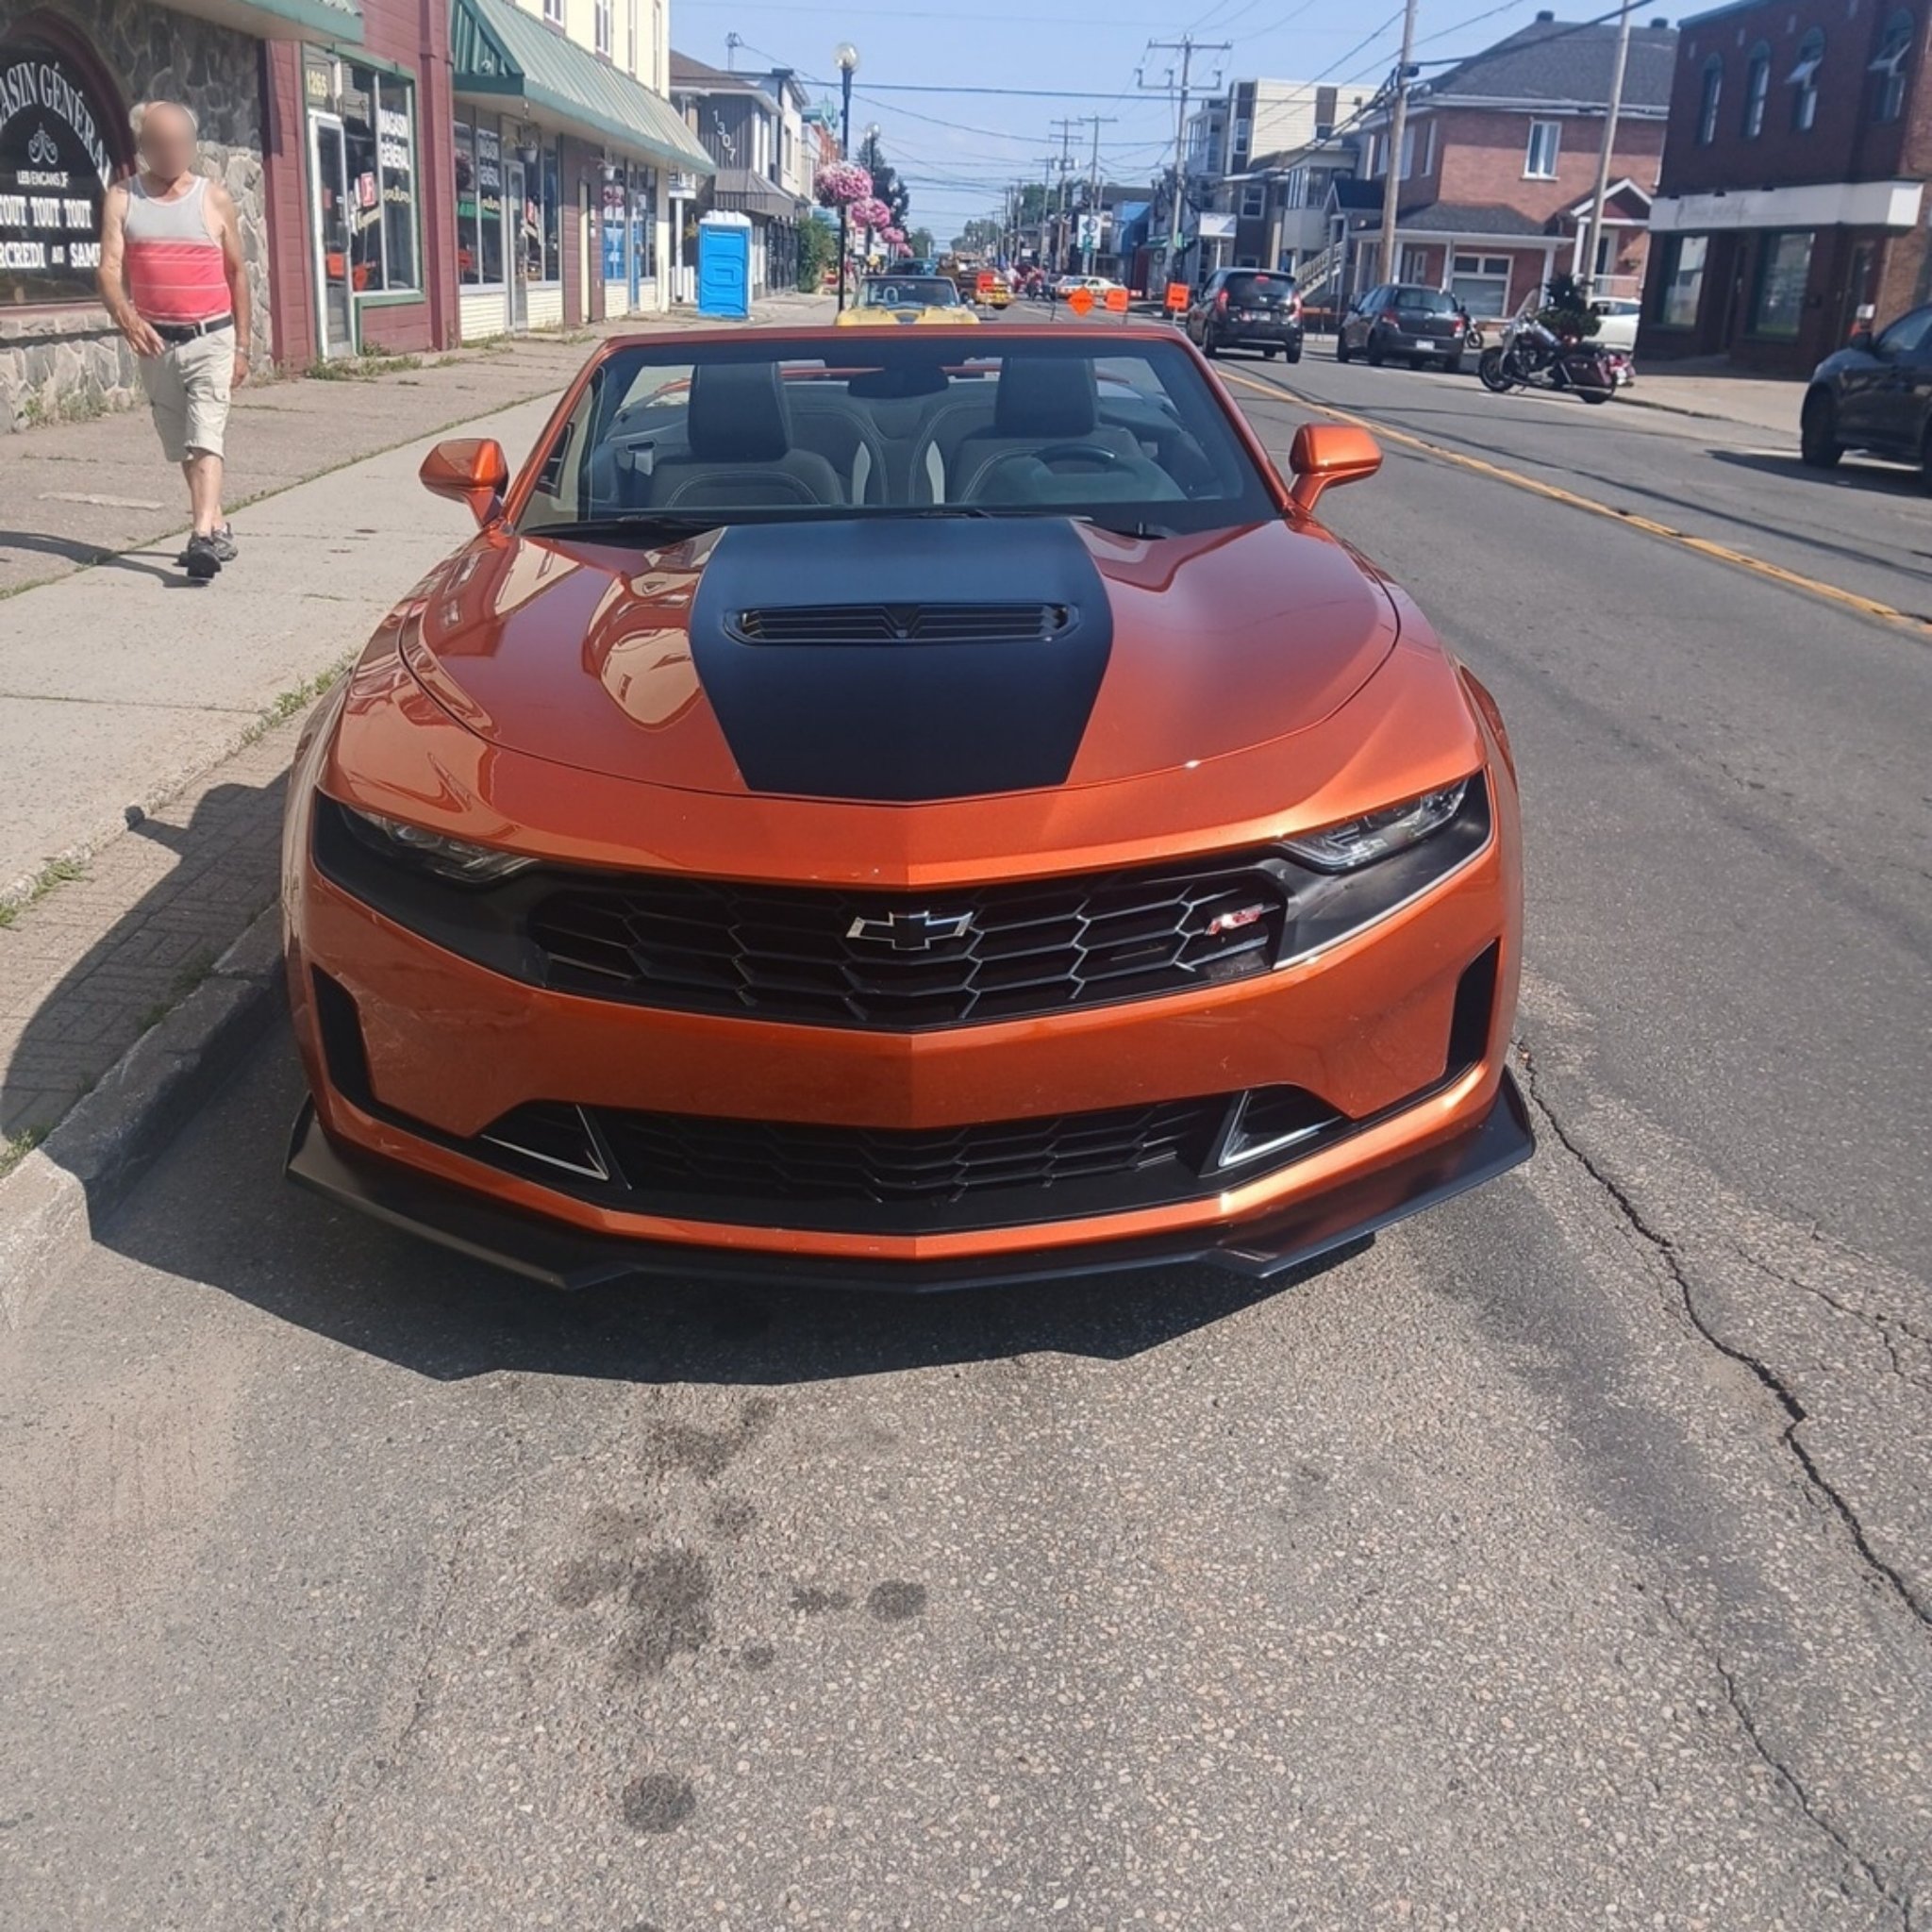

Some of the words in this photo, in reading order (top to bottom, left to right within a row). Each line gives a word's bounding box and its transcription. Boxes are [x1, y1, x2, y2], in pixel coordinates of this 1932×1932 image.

[0, 61, 38, 130] ASIN
[712, 109, 736, 161] 1307
[30, 195, 61, 227] TOUT
[63, 198, 92, 228] TOUT
[69, 242, 101, 268] SAM
